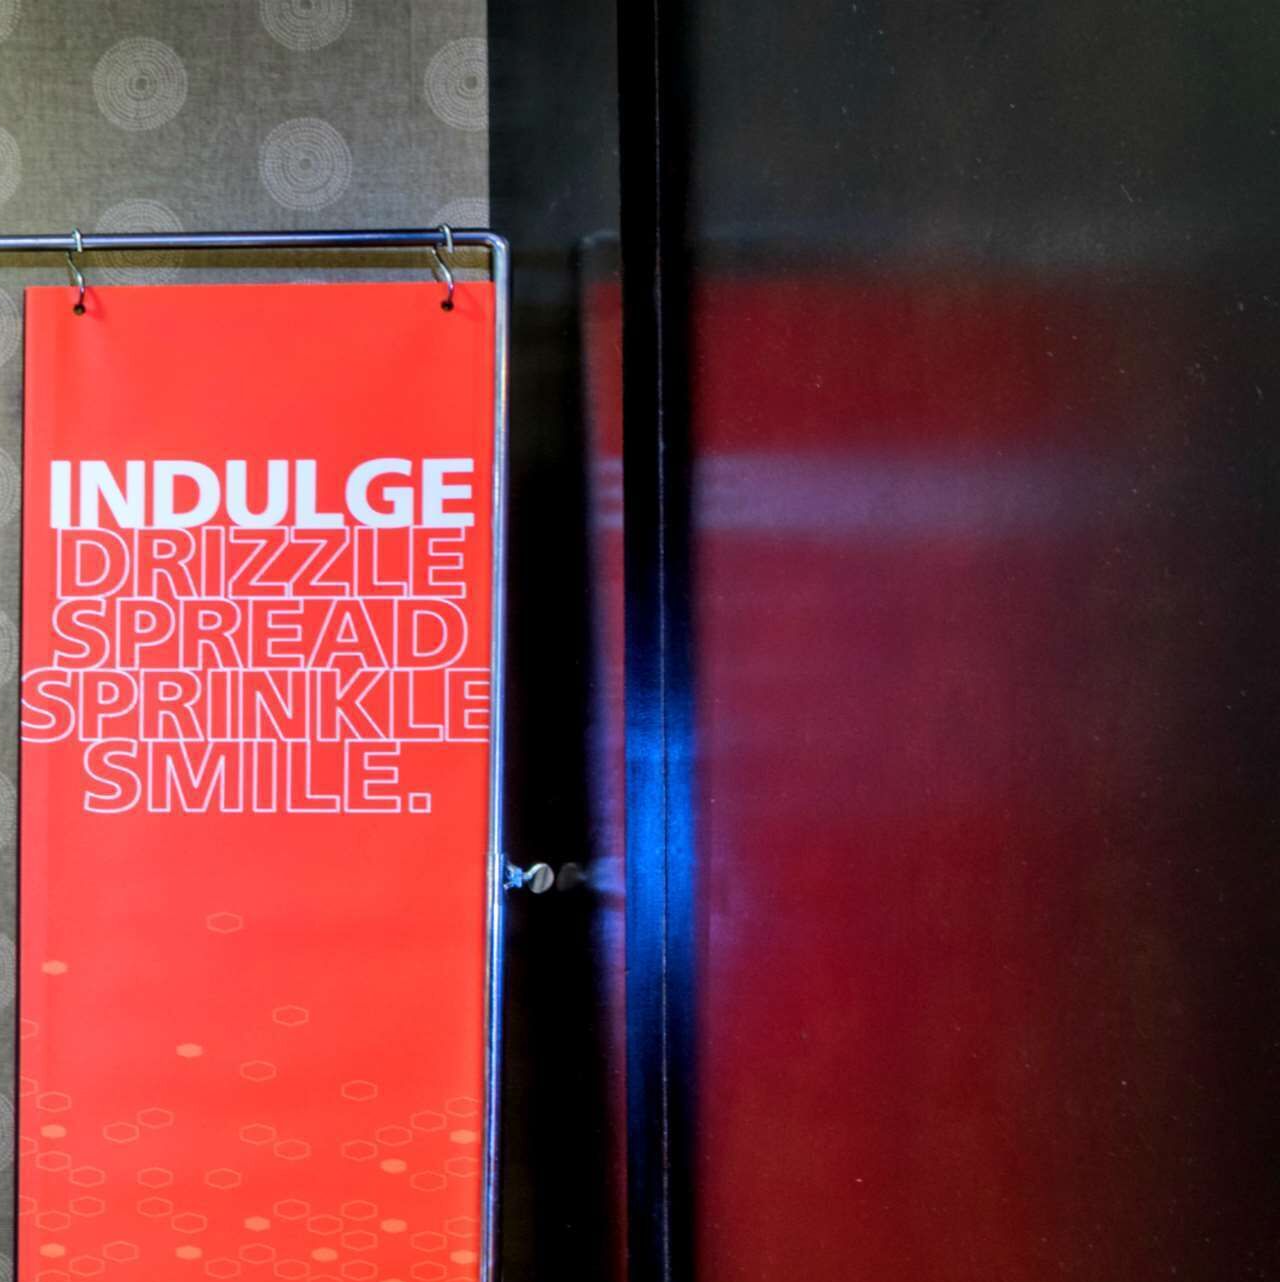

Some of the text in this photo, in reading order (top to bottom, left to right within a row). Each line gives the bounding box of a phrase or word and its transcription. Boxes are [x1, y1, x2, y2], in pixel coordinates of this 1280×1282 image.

[50, 458, 475, 529] INDULGE
[56, 526, 467, 600] DRIZZLE
[51, 597, 468, 670] SPREAD
[20, 667, 490, 743] SPRINKLE
[83, 738, 431, 813] SMILE.
